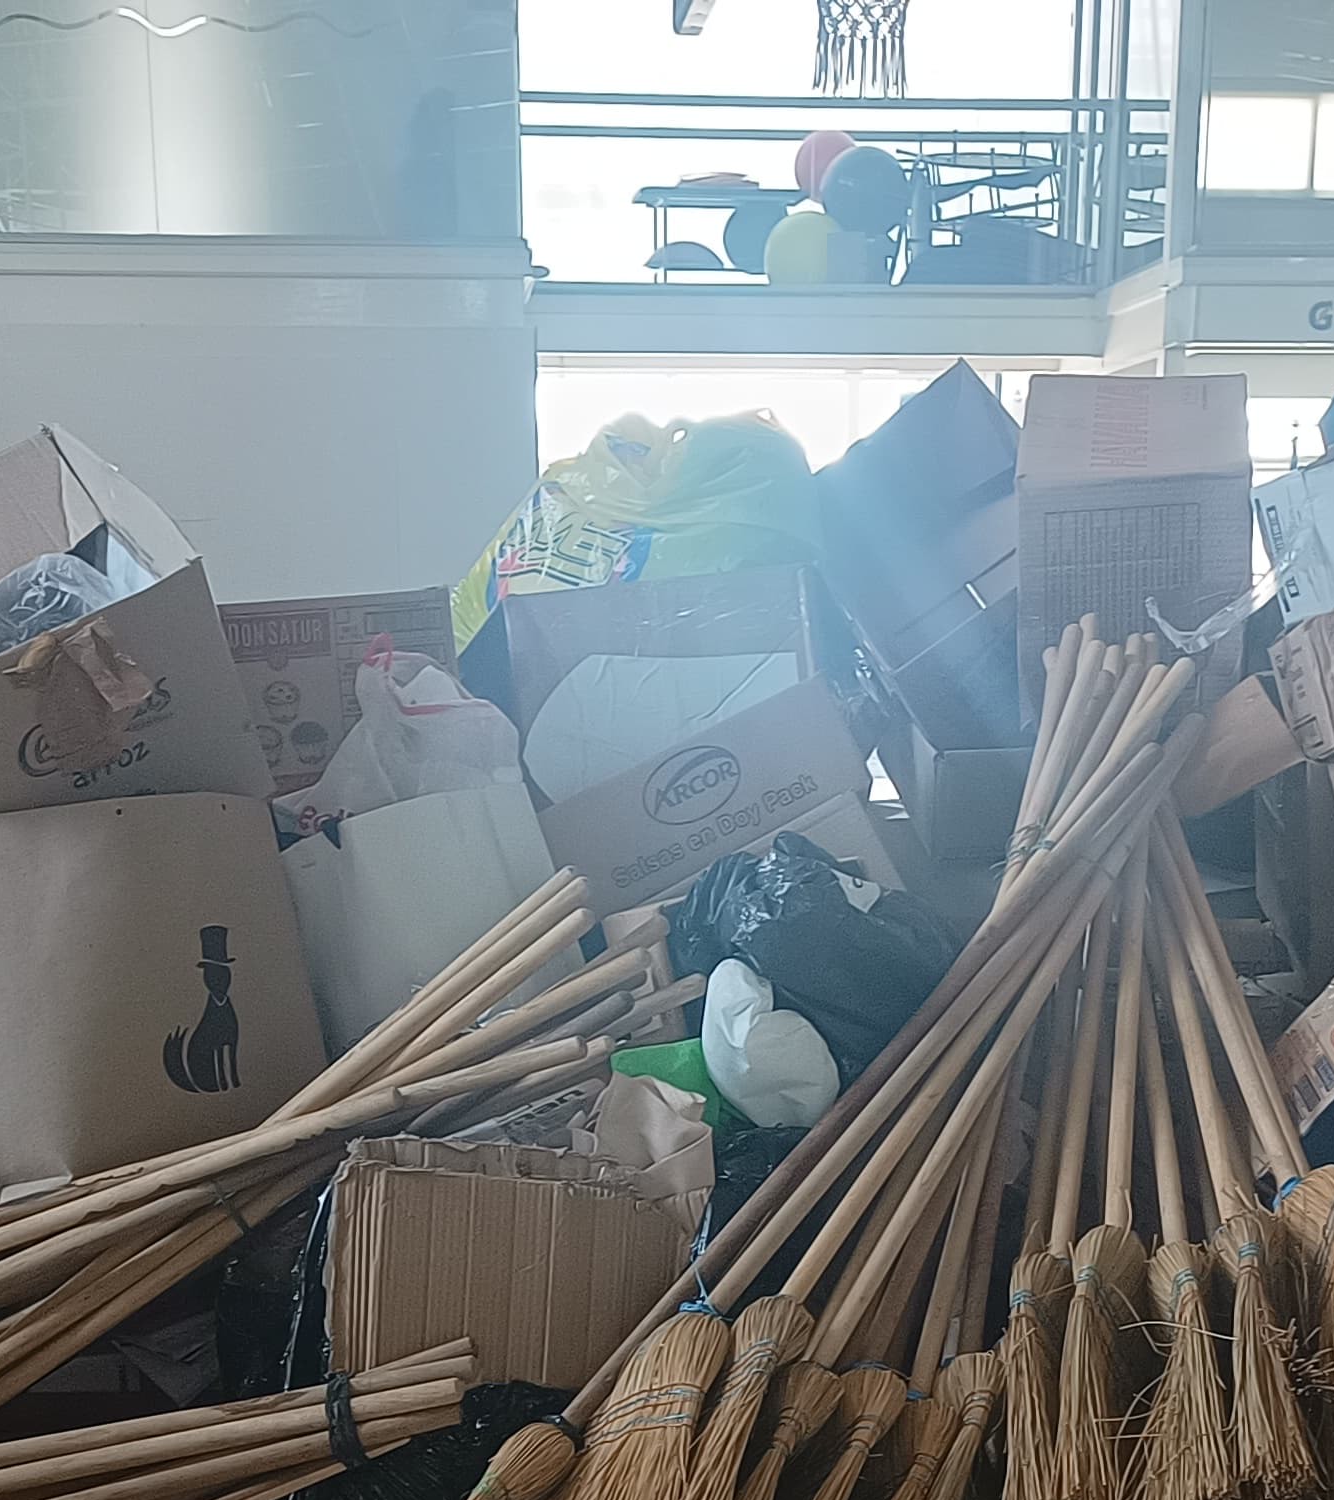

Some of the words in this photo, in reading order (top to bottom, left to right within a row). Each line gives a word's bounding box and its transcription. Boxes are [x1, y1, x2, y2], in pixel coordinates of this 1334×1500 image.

[268, 619, 325, 647] SATUR
[72, 740, 150, 788] arroz
[653, 759, 740, 816] ARCOR
[611, 839, 685, 888] Salsas
[687, 826, 718, 852] en
[717, 804, 762, 836] Doy
[762, 773, 818, 813] Pack
